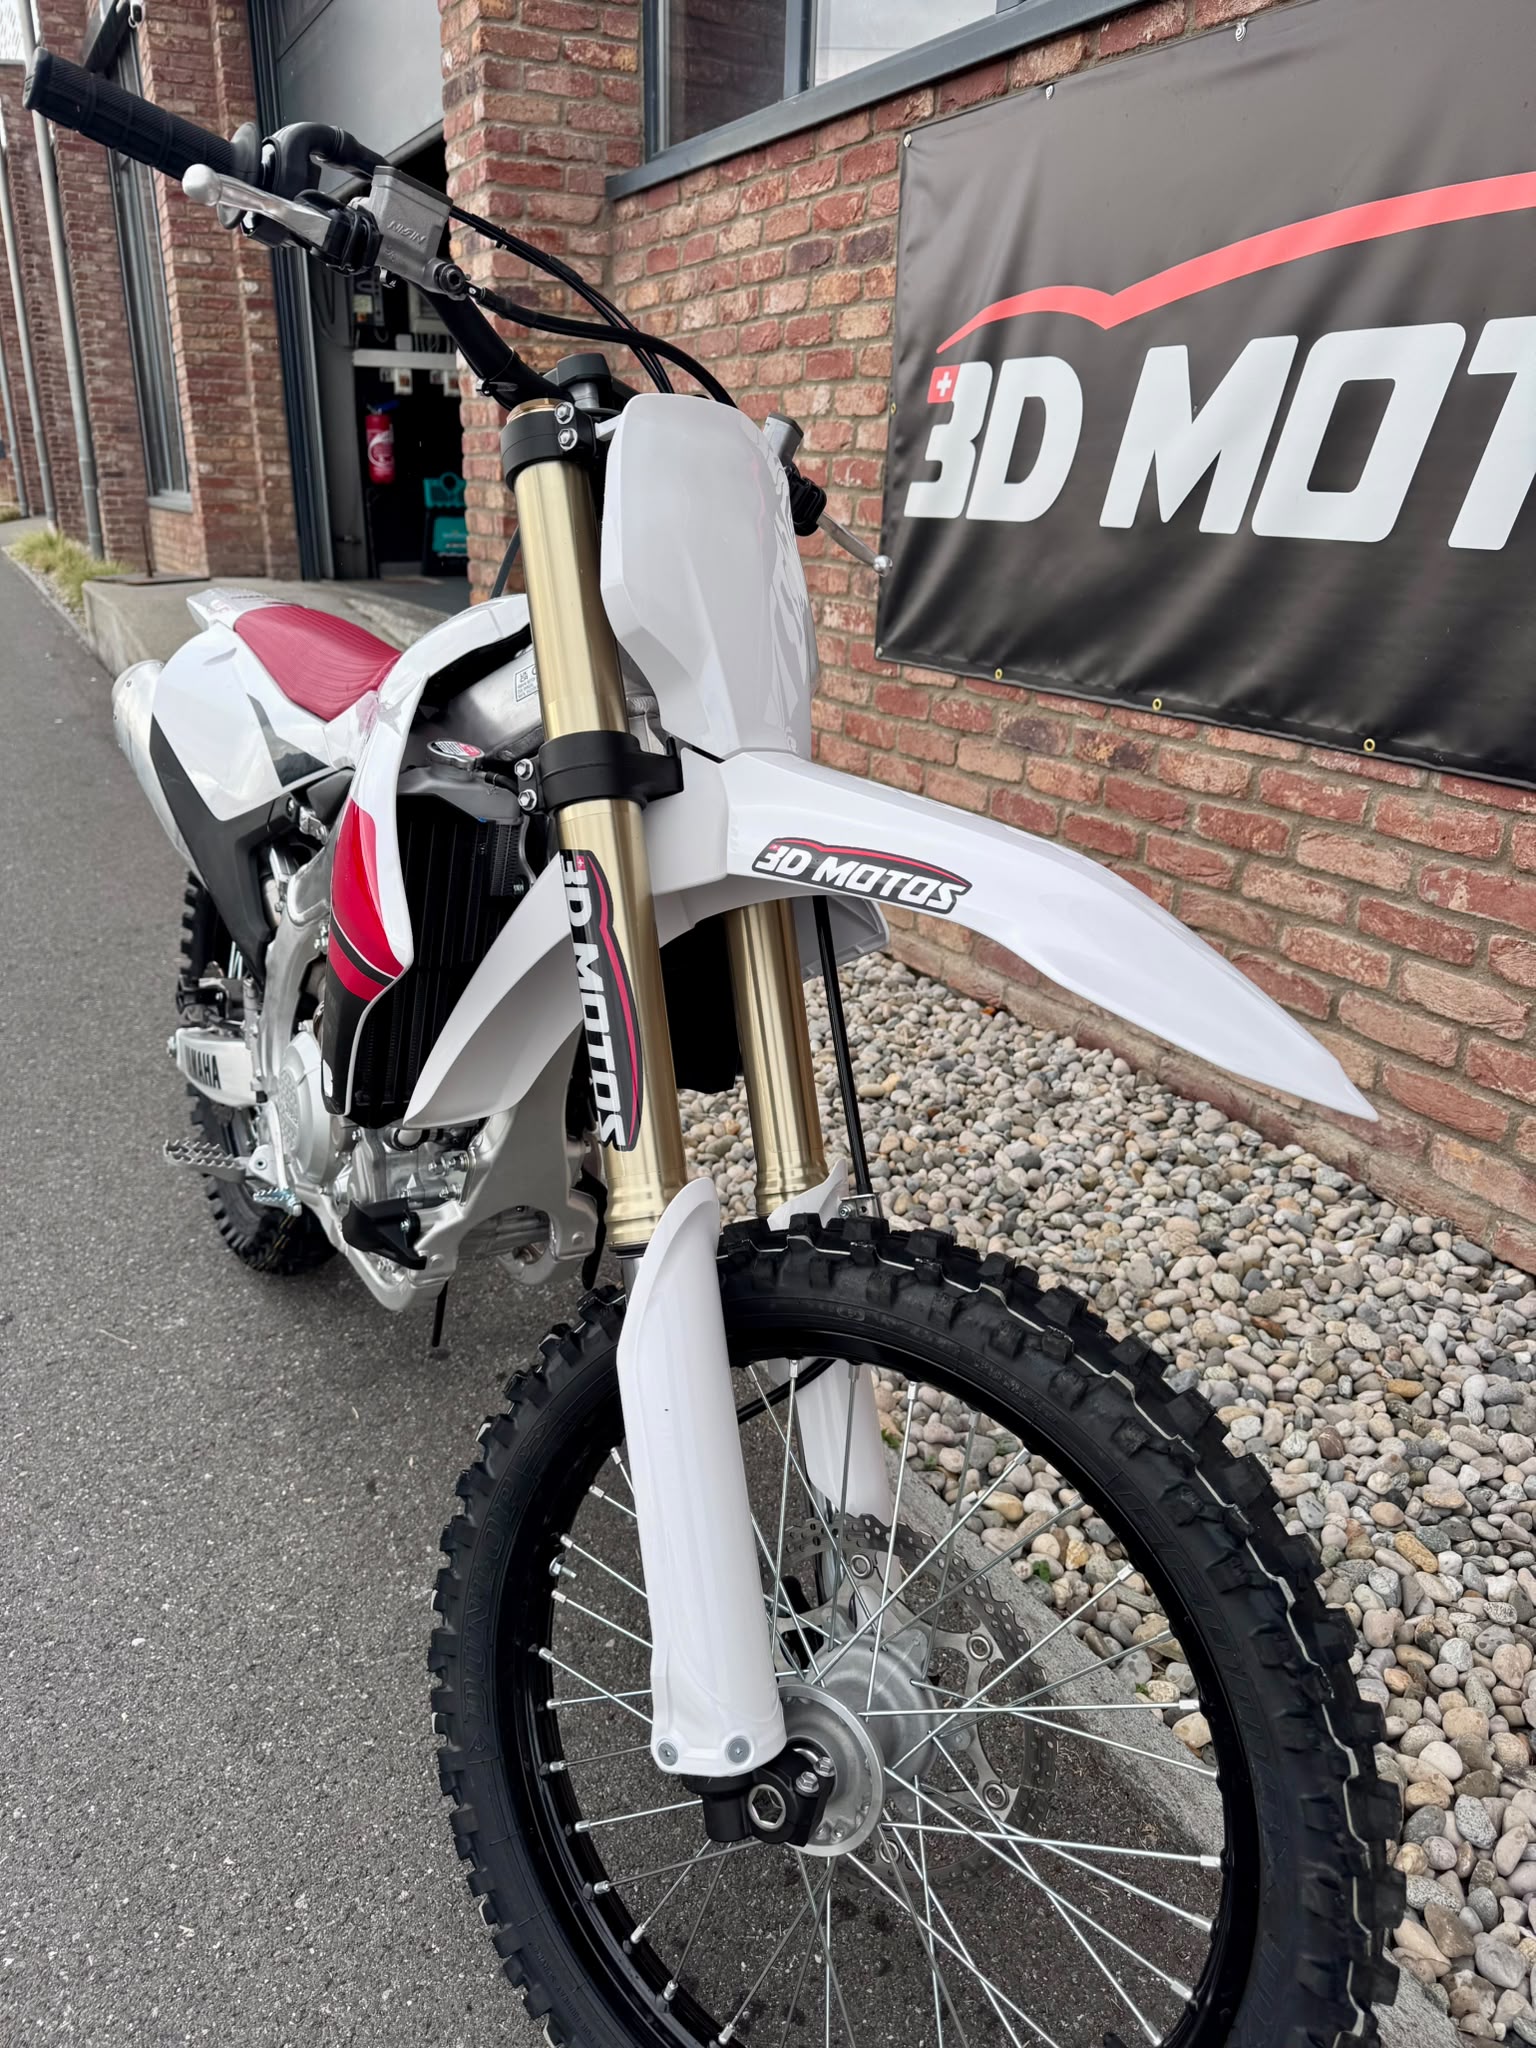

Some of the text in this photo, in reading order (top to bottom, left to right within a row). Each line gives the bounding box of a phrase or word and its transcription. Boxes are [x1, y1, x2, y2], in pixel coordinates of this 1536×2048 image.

[904, 355, 1083, 522] 3D
[755, 844, 967, 911] 3D MOTOS
[561, 856, 626, 1147] 3D MOTOS
[463, 1475, 516, 1722] DUNLOP
